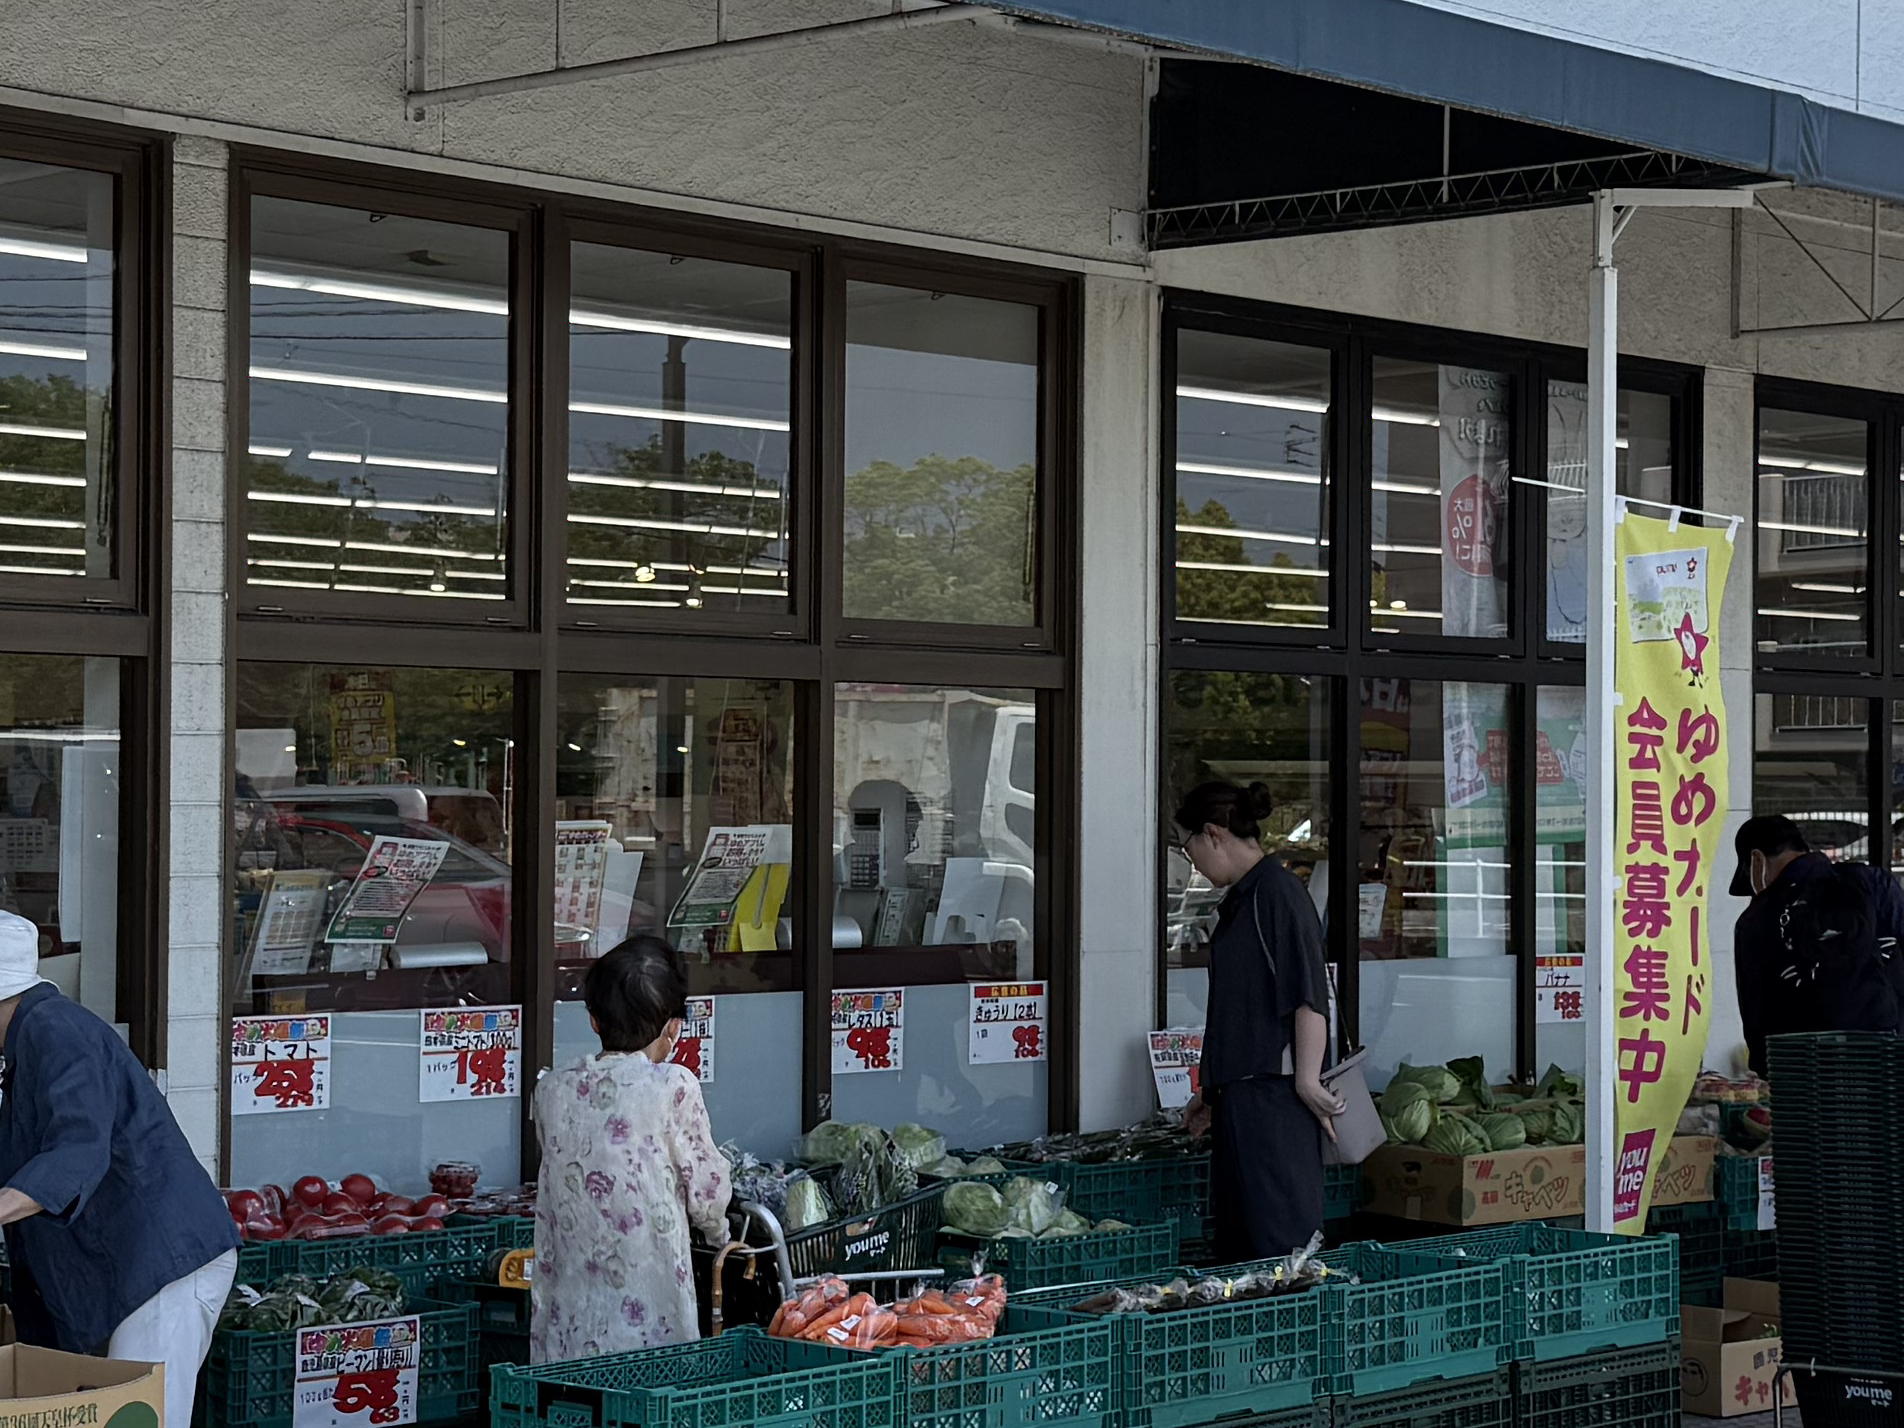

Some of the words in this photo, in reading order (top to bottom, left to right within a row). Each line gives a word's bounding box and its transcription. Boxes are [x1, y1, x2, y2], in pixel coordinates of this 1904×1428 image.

[1616, 695, 1672, 1104] 会員募集中
[264, 1041, 318, 1062] トマト
[846, 1027, 892, 1059] 98
[1012, 1024, 1041, 1048] 98
[1618, 1146, 1649, 1179] you
[1504, 1170, 1569, 1212] キャベツ
[1617, 1170, 1644, 1195] me
[845, 1231, 891, 1262] youme
[332, 1368, 401, 1414] 58
